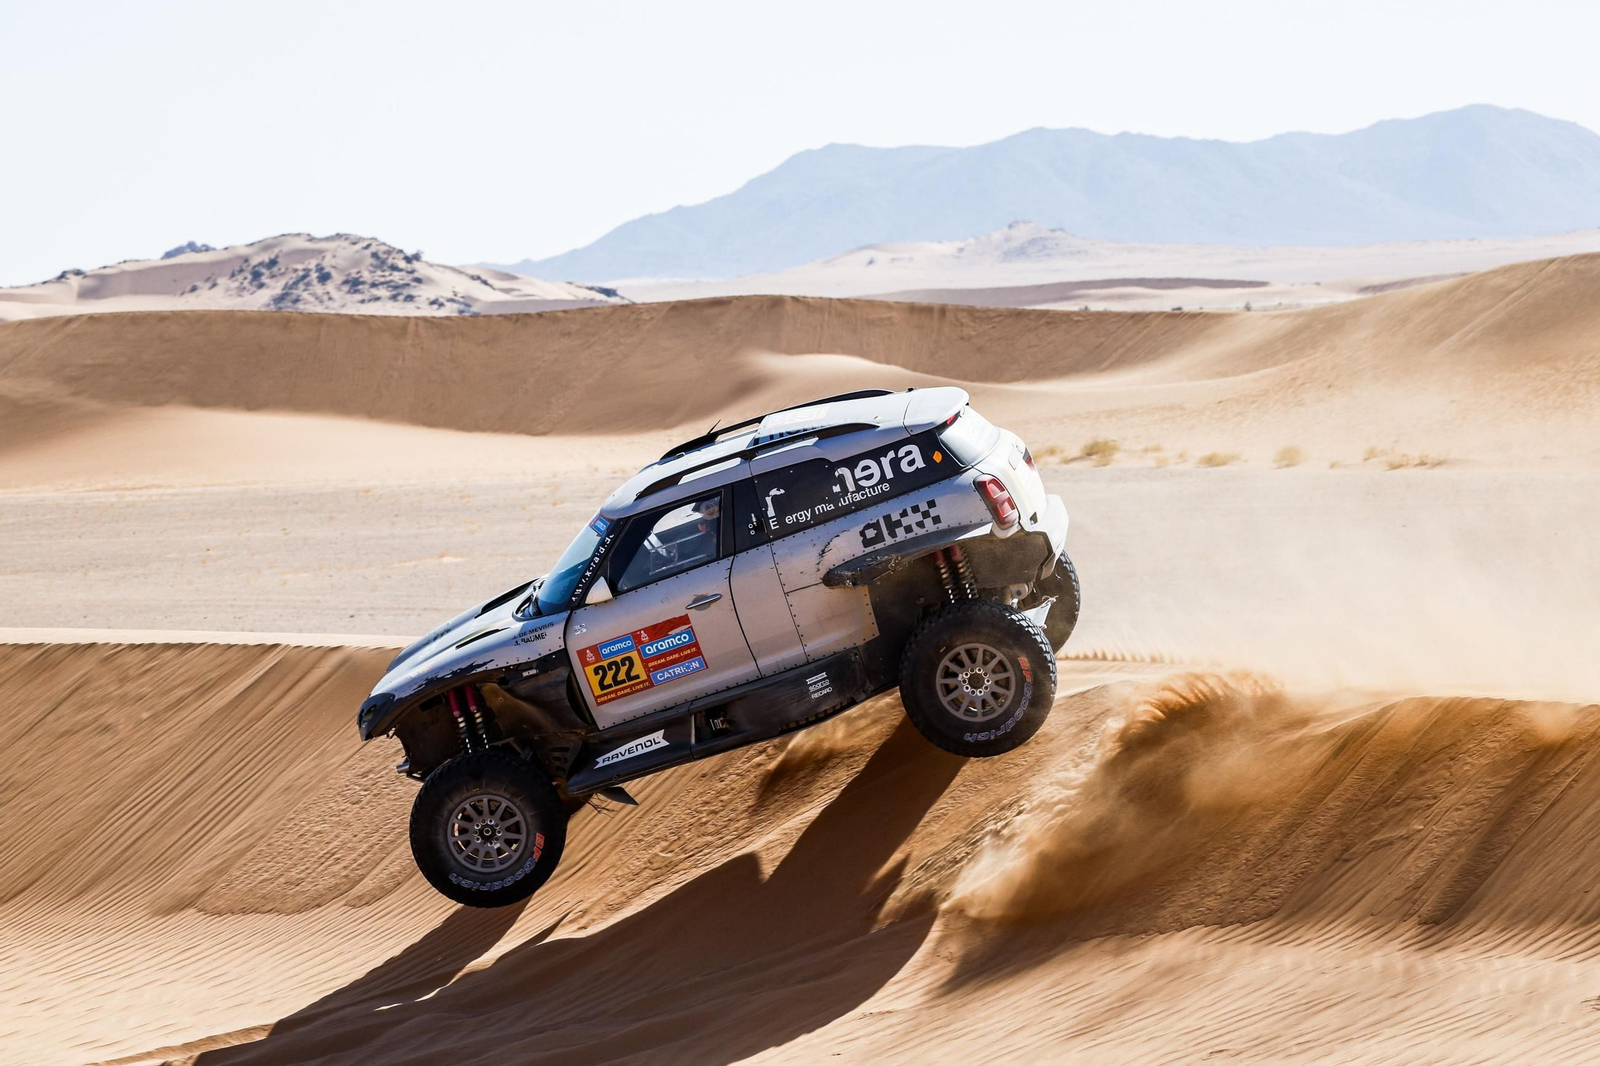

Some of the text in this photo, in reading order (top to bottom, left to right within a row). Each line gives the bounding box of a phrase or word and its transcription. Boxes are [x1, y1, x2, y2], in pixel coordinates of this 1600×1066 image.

[601, 640, 632, 655] aramco
[645, 633, 690, 655] aramco
[592, 656, 641, 692] 222
[602, 737, 661, 764] RAVENOL
